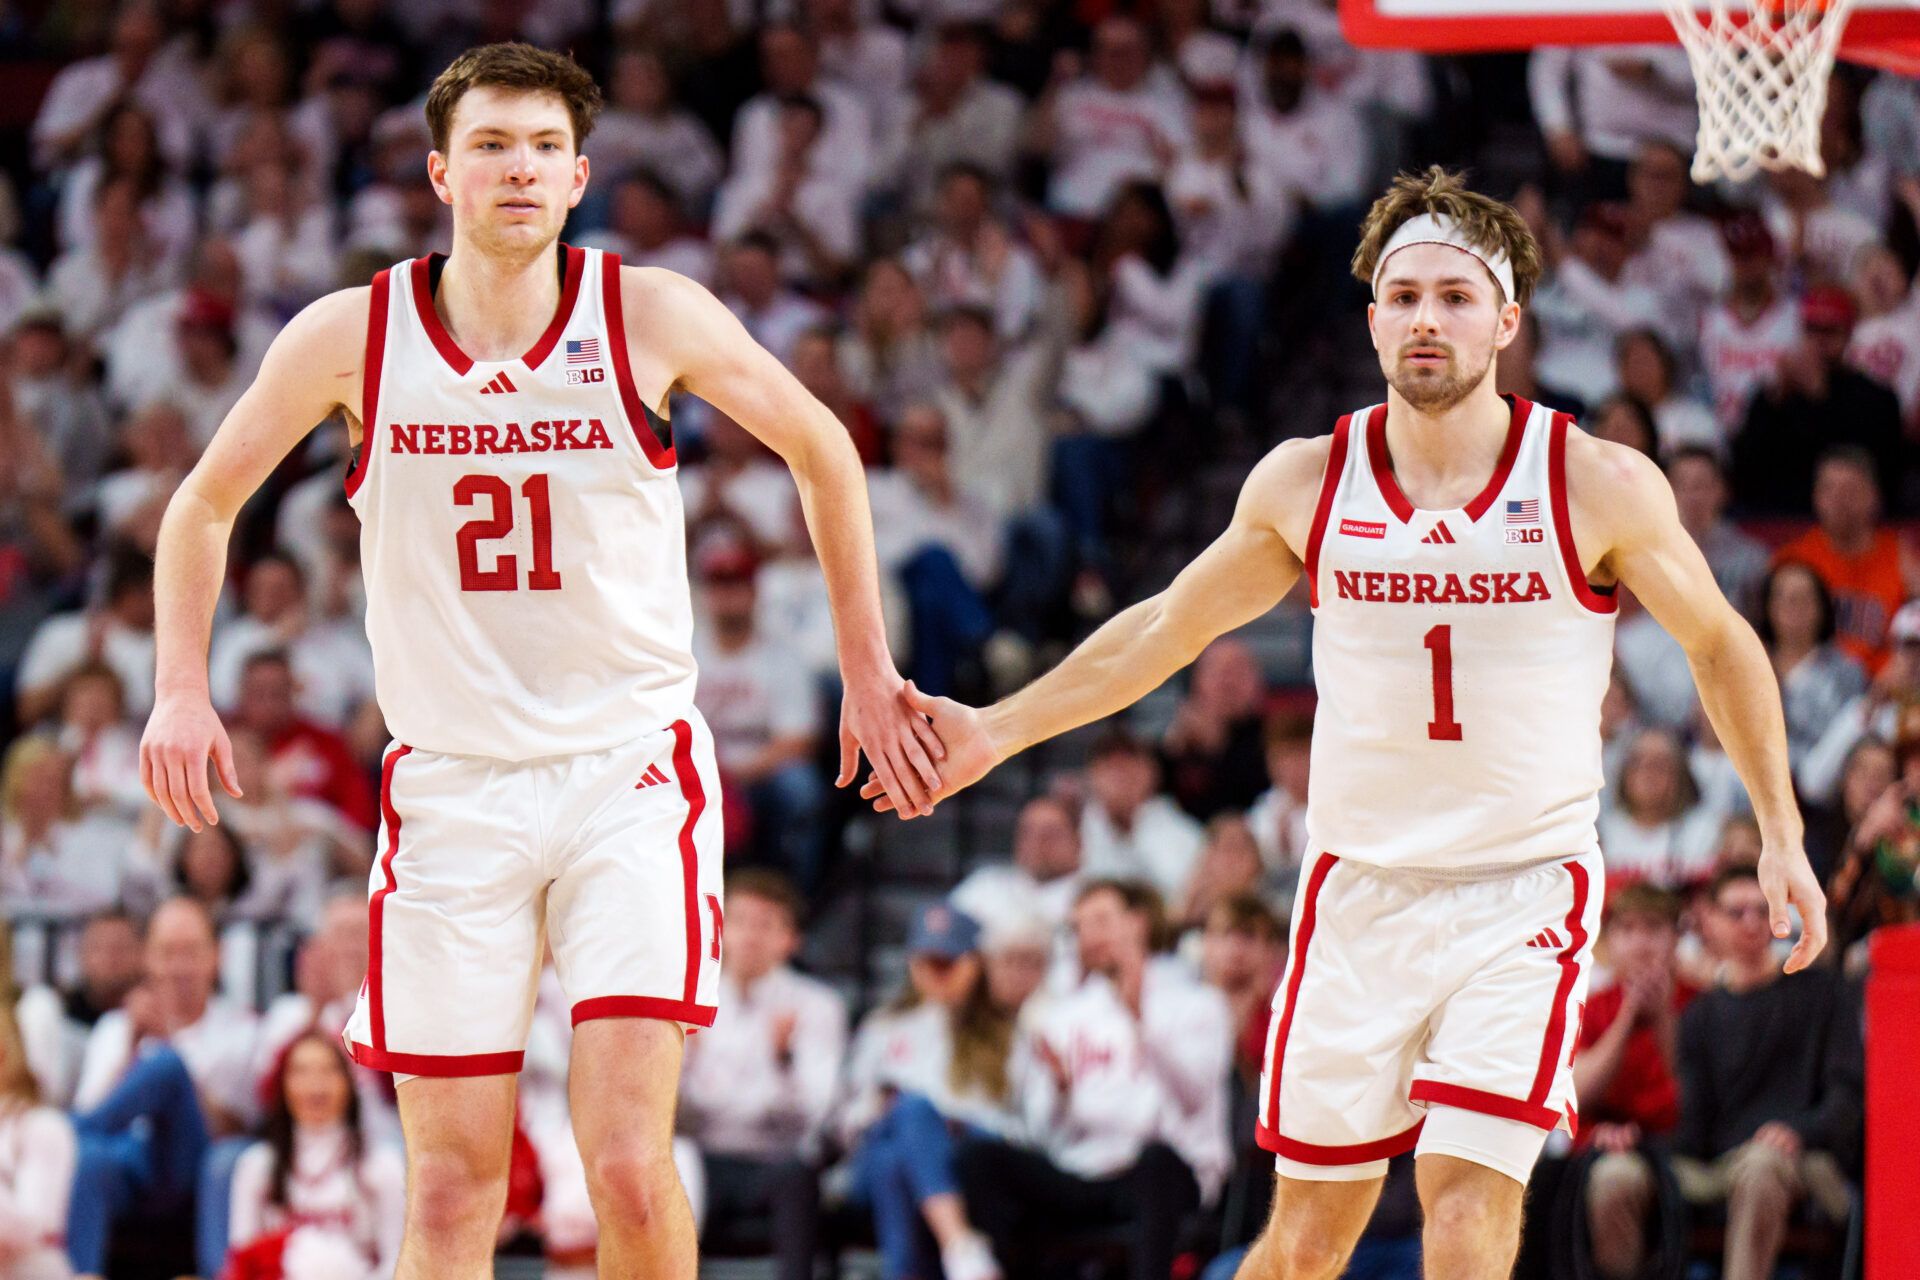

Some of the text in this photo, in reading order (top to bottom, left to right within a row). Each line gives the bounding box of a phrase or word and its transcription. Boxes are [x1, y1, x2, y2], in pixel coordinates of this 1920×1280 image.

[390, 418, 614, 455] NEBRASKA
[453, 473, 562, 591] 21
[1342, 524, 1385, 535] GRADUATE
[1334, 570, 1551, 604] NEBRASKA
[1424, 624, 1463, 741] 1
